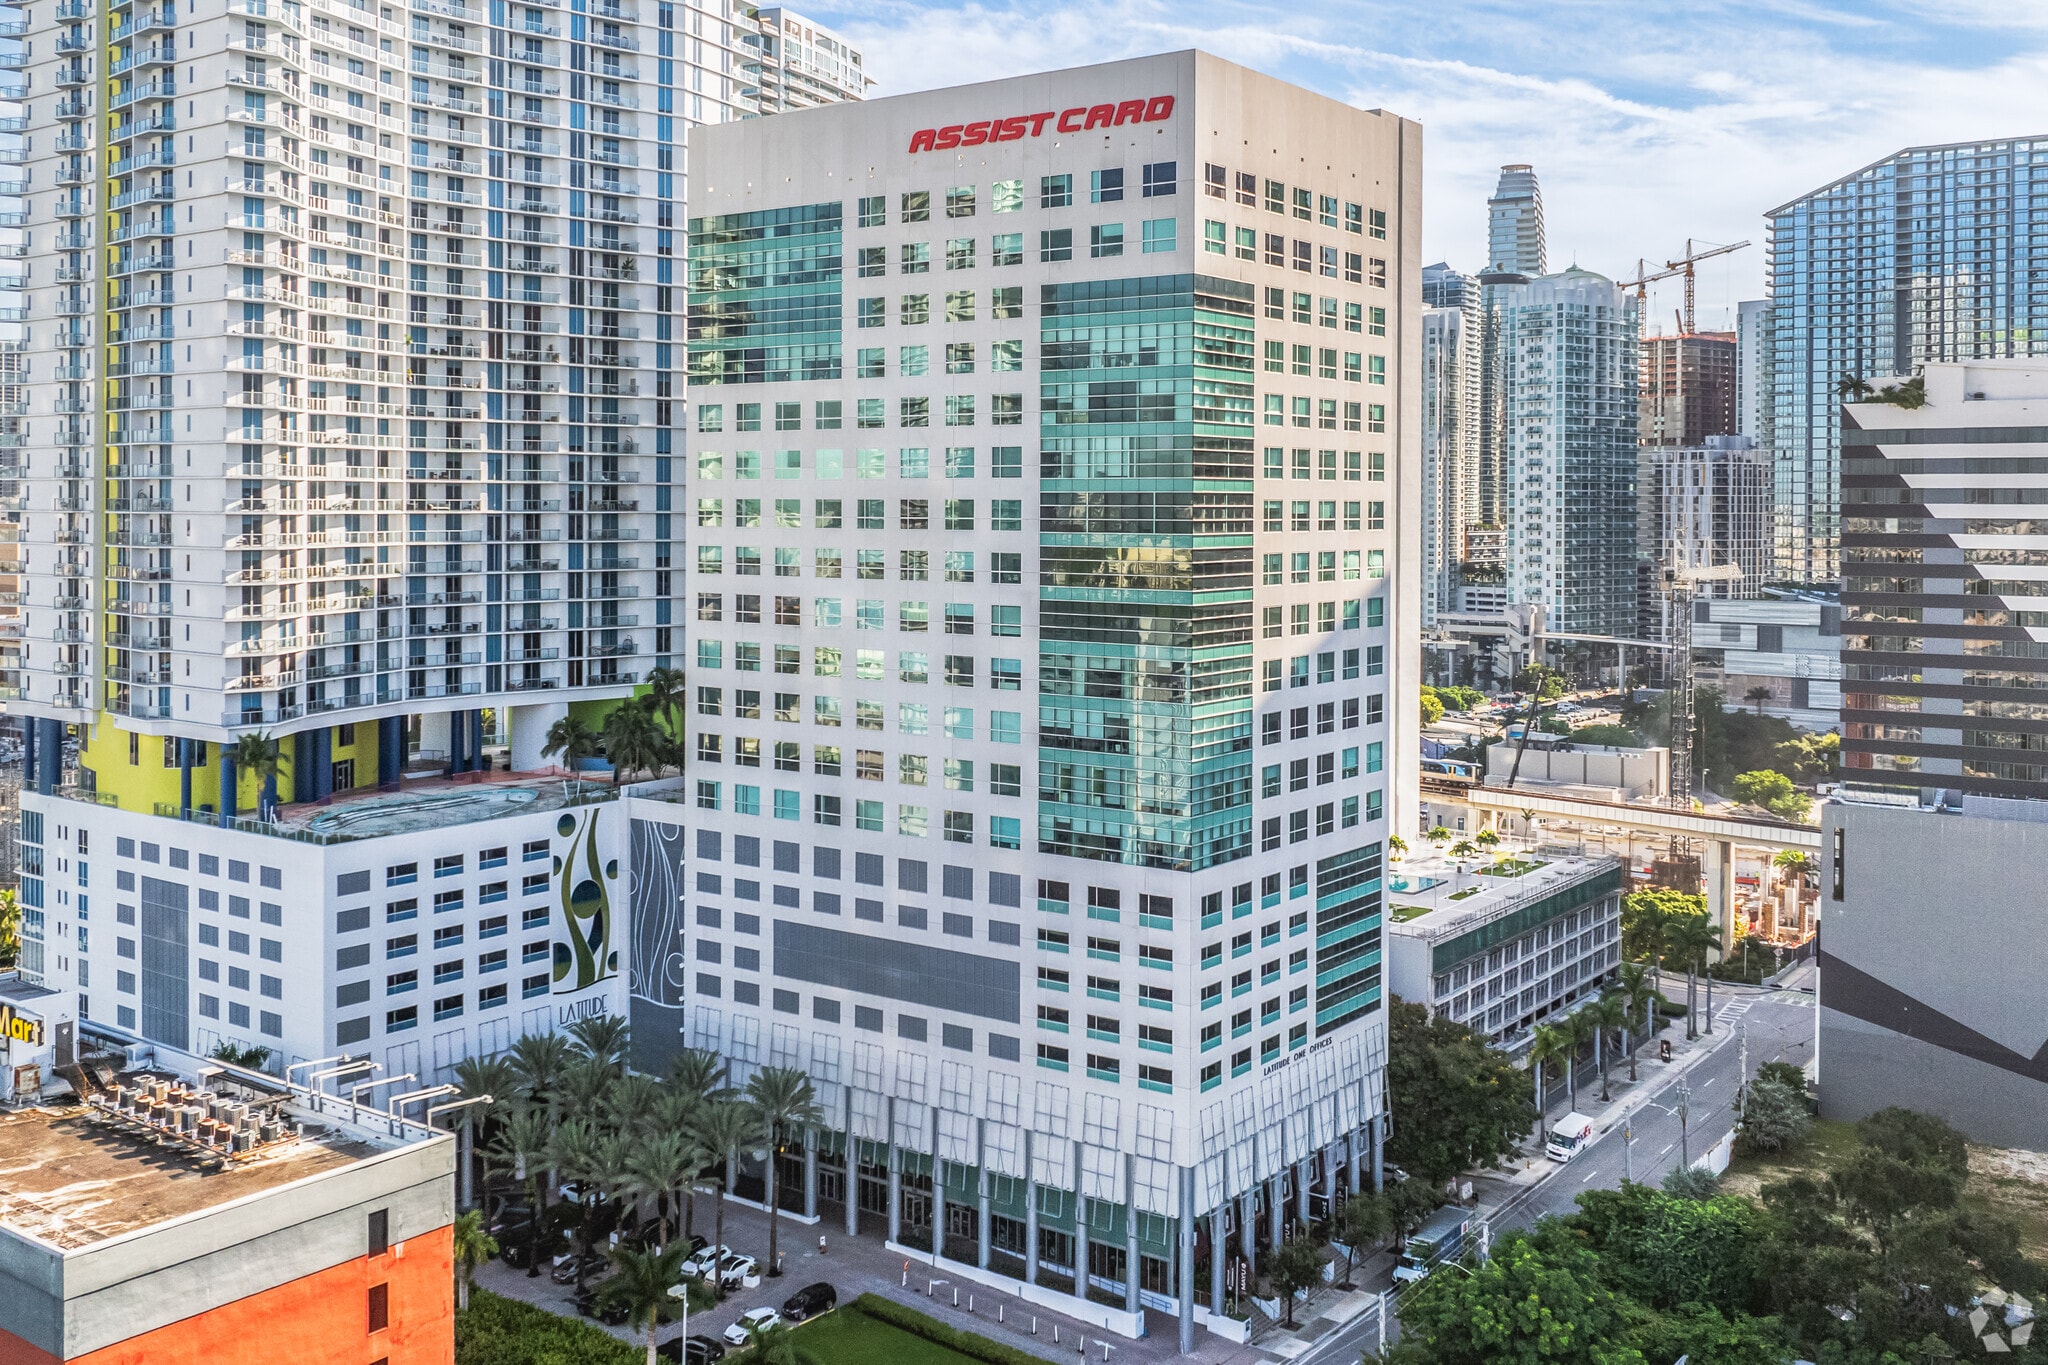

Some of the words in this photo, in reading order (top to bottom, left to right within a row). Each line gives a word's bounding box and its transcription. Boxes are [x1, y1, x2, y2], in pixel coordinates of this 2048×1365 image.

[909, 112, 1054, 154] ASSIST
[1056, 95, 1175, 133] CARD
[0, 1004, 41, 1047] Mart
[560, 994, 608, 1024] LATITUDE
[1263, 1056, 1290, 1076] LATITUDE
[1293, 1049, 1307, 1061] ONE
[1309, 1036, 1333, 1054] OFFICES
